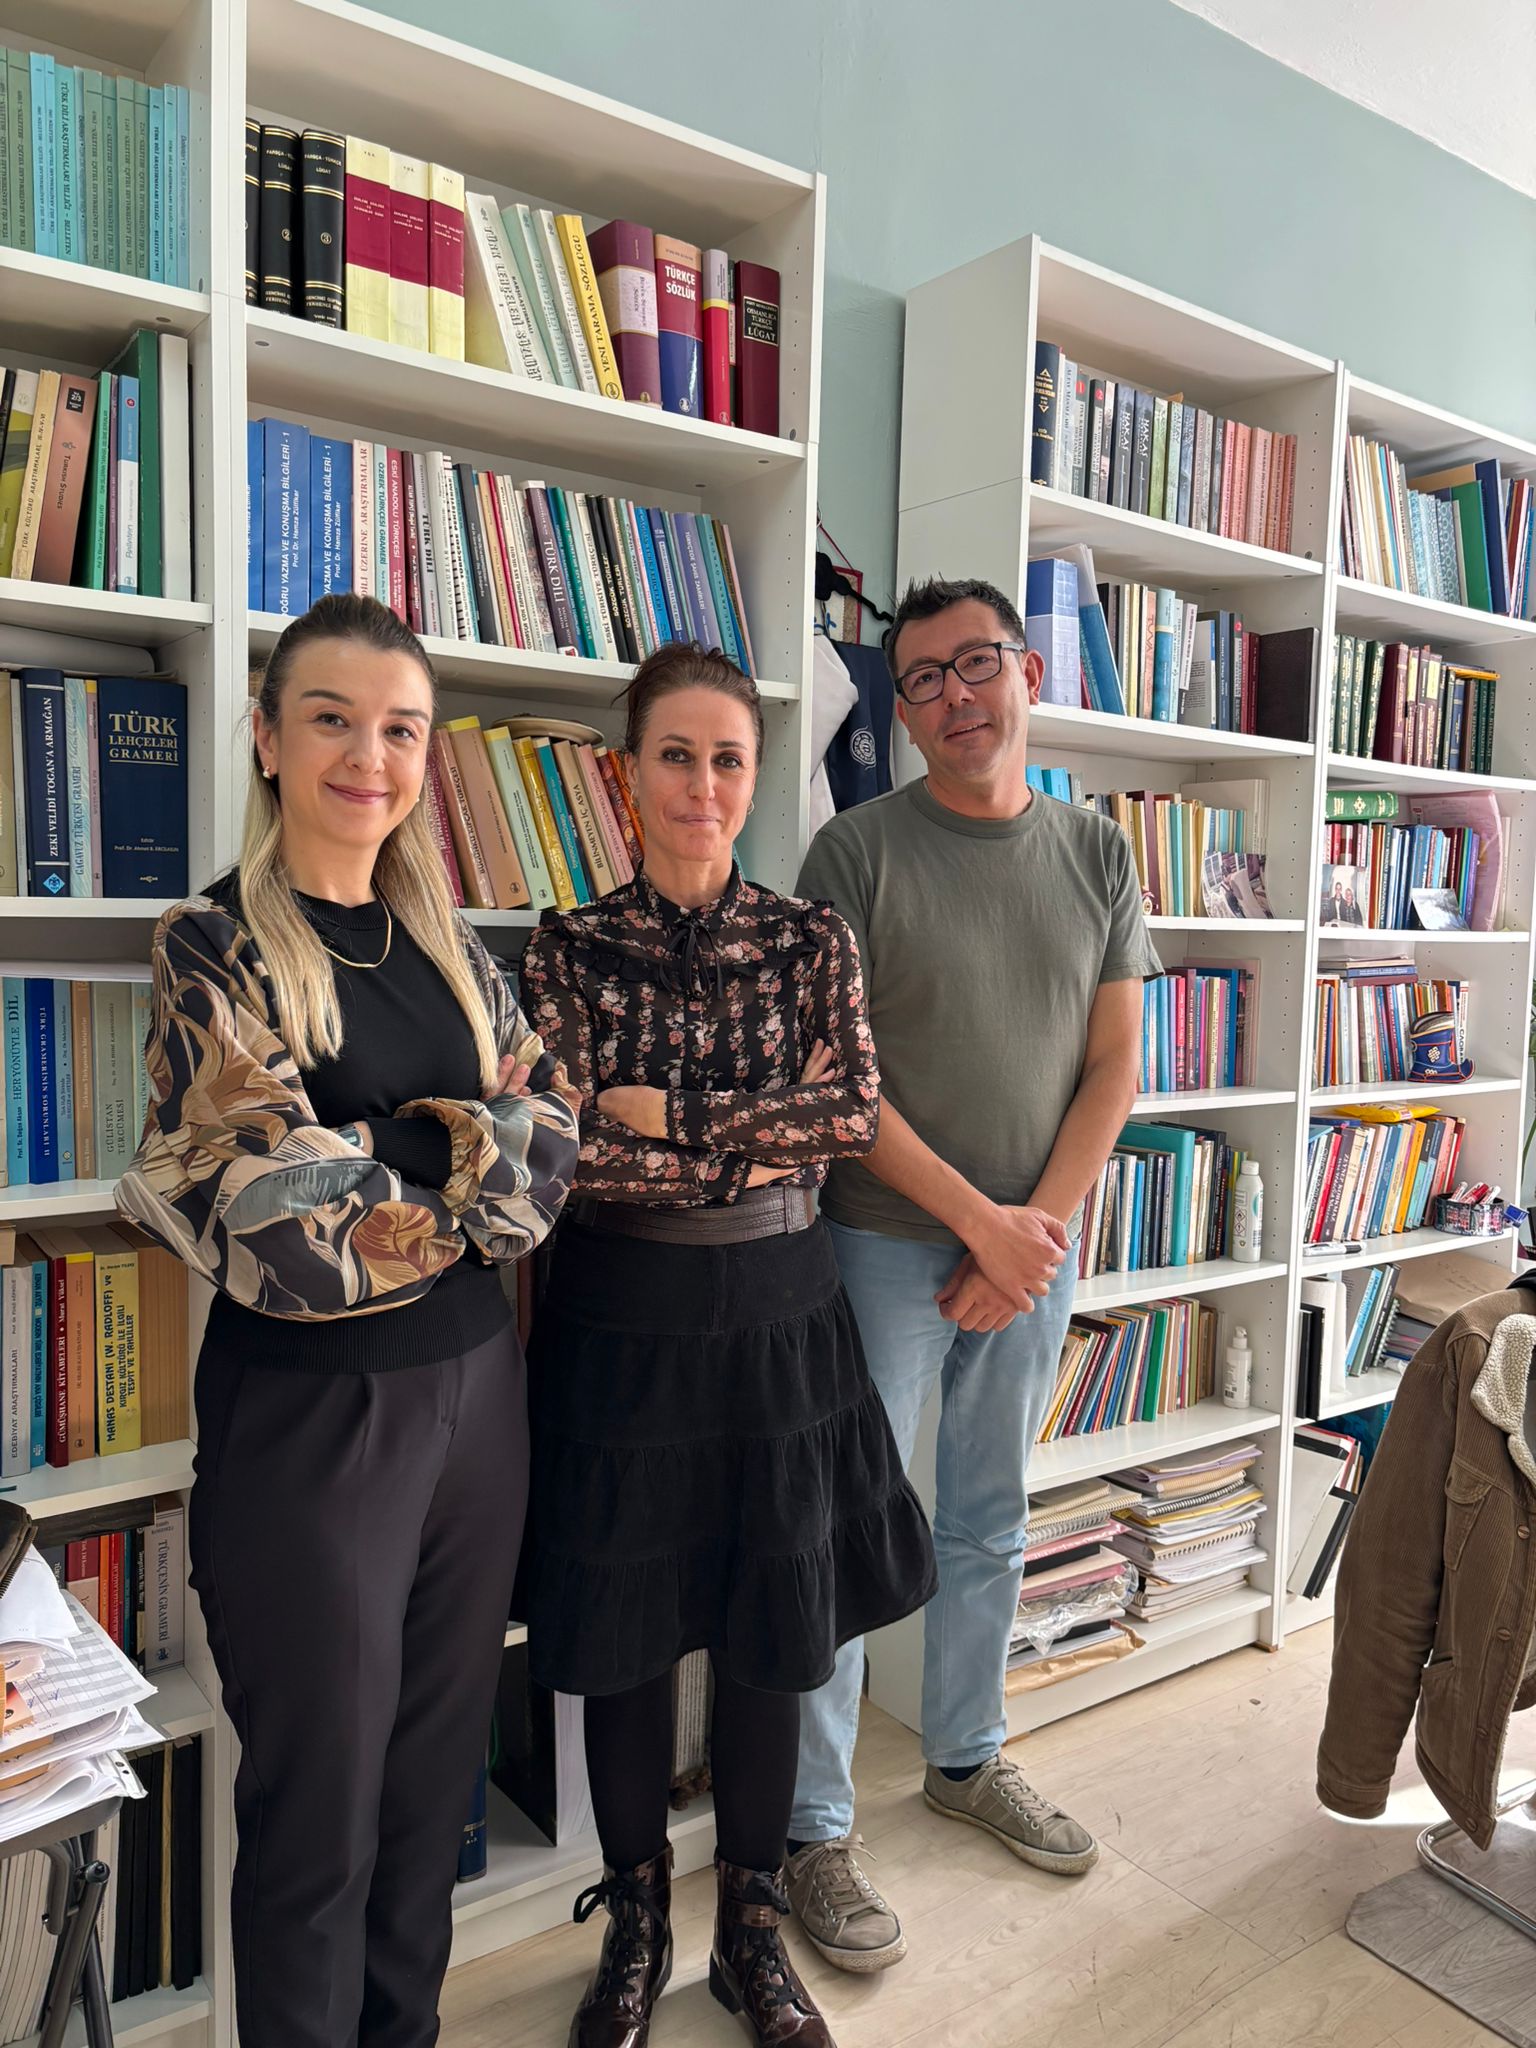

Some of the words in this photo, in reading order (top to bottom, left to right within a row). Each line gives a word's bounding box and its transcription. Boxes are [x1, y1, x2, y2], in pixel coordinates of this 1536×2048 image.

[62, 123, 70, 182] ARAŞTIRMALARI
[664, 264, 696, 286] TÜRKÇE
[665, 280, 697, 301] SÖZLÜK
[493, 262, 524, 328] LEHÇELERİ
[511, 276, 534, 335] KARŞILAŞTIRMALI
[587, 295, 604, 343] TARAMA
[598, 346, 610, 373] YENİ
[1121, 412, 1132, 451] HAKAS
[1140, 419, 1152, 458] HAKAS
[30, 444, 42, 494] ARAŞTIRMALARI
[280, 444, 289, 490] BİLGİLERİ
[323, 458, 332, 501] BİLGİLERİ
[391, 459, 399, 477] ESKİ
[292, 490, 300, 515] Zülfikar
[360, 449, 369, 526] ARAŞTIRMALAR
[391, 479, 399, 517] ANADOLU
[24, 498, 34, 527] KÜLTÜRÜ
[282, 493, 290, 536] KONUŞMA
[323, 504, 333, 548] KONUŞMA
[334, 502, 342, 527] Zülfikar
[377, 490, 387, 527] TÜRKÇESİ
[21, 532, 29, 548] TÜRK
[282, 540, 289, 552] VE
[334, 529, 342, 550] Hamza
[379, 529, 387, 564] GRAMERİ
[392, 520, 401, 557] TÜRKÇESİ
[422, 513, 433, 545] TÜRK
[324, 552, 331, 562] VE
[359, 530, 368, 572] ÜZERİNE
[425, 548, 435, 574] DİLİ
[543, 538, 560, 575] TÜRK
[584, 532, 601, 578] TÜRKÇESİ
[324, 565, 332, 594] YAZMA
[550, 575, 566, 602] DİLİ
[683, 532, 696, 561] TÜRKÇEDE
[694, 580, 707, 611] ZAMİRLERİ
[593, 580, 608, 621] TÜRKİYE
[602, 624, 613, 644] ESKİ
[42, 697, 54, 748] ARMAĞAN
[108, 710, 178, 737] TÜRK
[108, 735, 178, 749] LEHÇELERİ
[109, 748, 179, 762] GRAMERİ
[44, 751, 56, 794] TOGAN'A
[70, 766, 82, 800] GRAMERİ
[572, 784, 584, 807] ASYA
[46, 797, 57, 830] VELİDİ
[71, 803, 85, 838] TÜRKÇESİ
[579, 808, 590, 819] İÇ
[48, 834, 58, 856] ZEKİ
[74, 841, 85, 875] GAGAVUZ
[470, 835, 485, 875] BUGÜNKÜ
[583, 821, 604, 869] BİLİNMEYEN
[6, 995, 19, 1022] DİL
[9, 1027, 22, 1076] YÖNÜYLE
[39, 1034, 49, 1091] GRAMERİNİN
[13, 1077, 23, 1100] HER
[42, 1094, 50, 1145] SORUNLARI
[105, 1104, 114, 1152] GÜLİSTAN
[115, 1099, 126, 1153] TERCÜMESİ
[57, 1279, 65, 1299] Yüksel
[105, 1275, 111, 1285] ve
[102, 1290, 114, 1337] RADLOFF)
[116, 1305, 124, 1326] İLGİLİ
[104, 1342, 114, 1358] (W.
[117, 1330, 125, 1340] İLE
[126, 1314, 134, 1355] TAHLİLLER
[56, 1337, 66, 1386] KİTABELERİ
[118, 1344, 126, 1378] KÜLTÜRÜ
[127, 1357, 134, 1367] VE
[11, 1350, 19, 1415] ARAŞTIRMALARI
[105, 1363, 114, 1403] DESTANI
[127, 1371, 135, 1396] TESPİT
[58, 1389, 67, 1442] GÜMÜŞHANE
[106, 1407, 116, 1441] MANAS
[157, 1540, 169, 1595] TÜRKÇENİN
[158, 1598, 170, 1641] GRAMERİ
